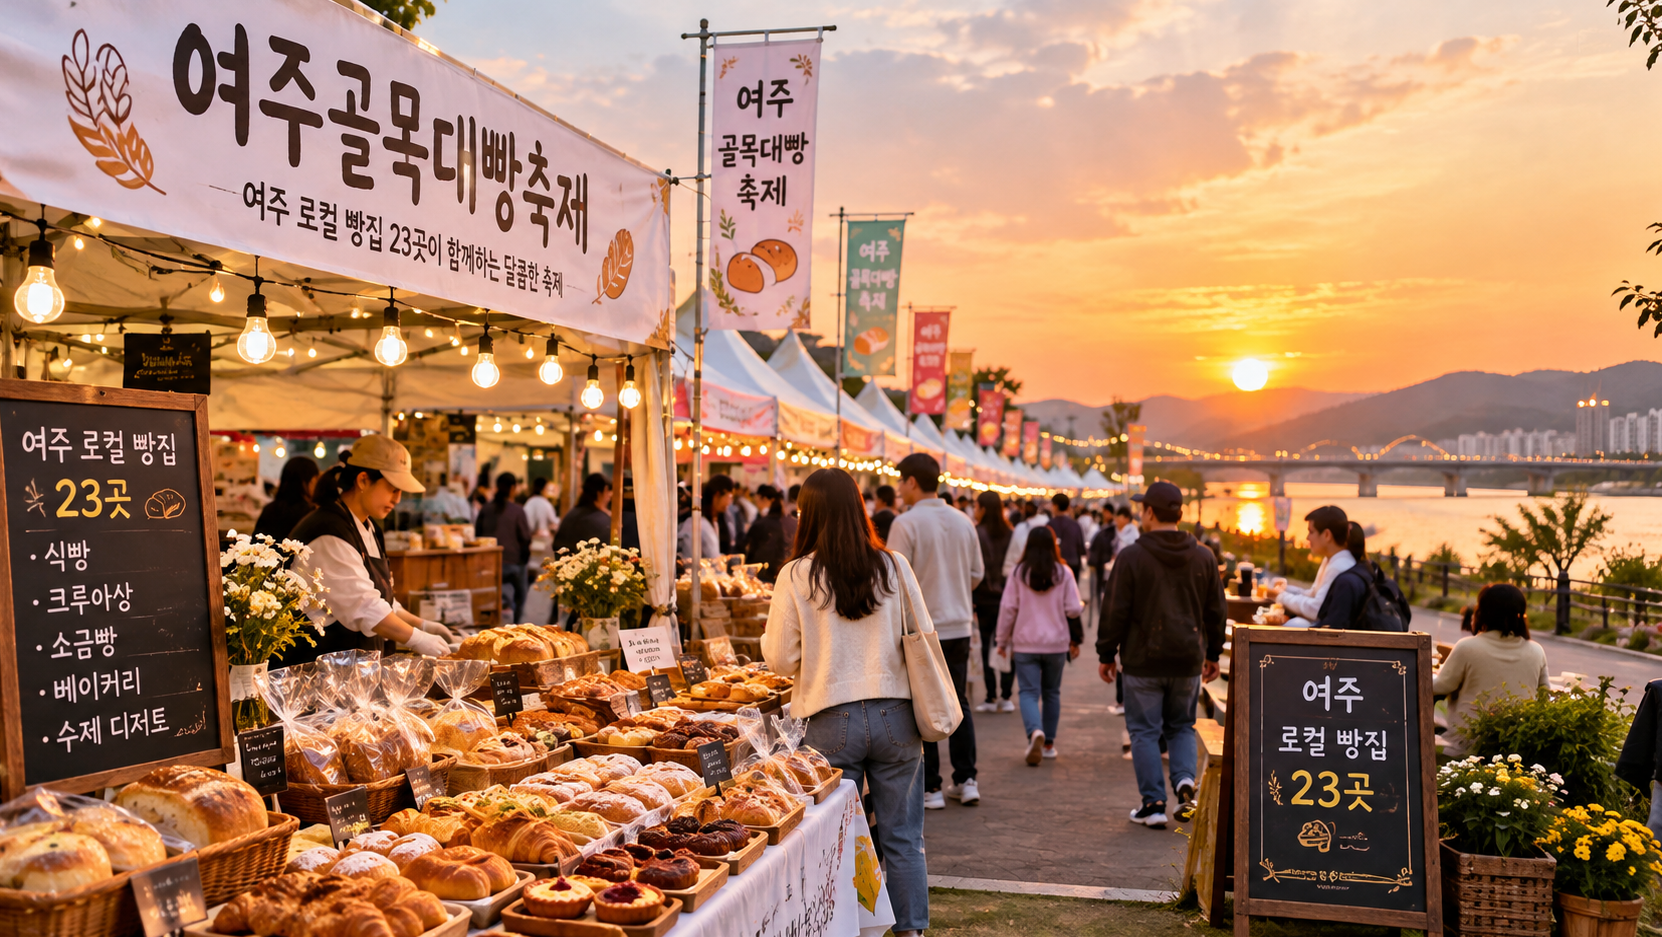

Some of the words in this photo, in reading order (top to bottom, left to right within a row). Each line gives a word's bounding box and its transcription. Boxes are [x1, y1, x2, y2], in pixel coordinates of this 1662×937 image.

[737, 79, 794, 118] 여주
[173, 22, 588, 255] 여주골목대빵축제
[718, 132, 809, 167] 골목대빵
[737, 174, 787, 211] 축제
[243, 181, 290, 226] 여주
[297, 196, 338, 241] 로컬
[345, 209, 382, 252] 빵집
[389, 223, 441, 266] 23곳이
[447, 237, 501, 283] 함께하는
[504, 254, 539, 293] 달콤한
[542, 266, 563, 298] 축제
[859, 240, 890, 262] 여주
[22, 427, 73, 463] 여주
[80, 430, 125, 465] 로컬
[133, 432, 177, 466] 빵집
[55, 478, 132, 519] 23곳
[44, 540, 90, 571] 식빵
[47, 582, 133, 616] 크루아상
[50, 626, 118, 659] 소금빵
[53, 666, 141, 703] 베이커리
[1302, 675, 1364, 713] 여주
[56, 714, 101, 753] 수제
[1278, 726, 1325, 757] 로컬
[1337, 728, 1388, 761] 빵집
[1291, 769, 1374, 813] 23곳
